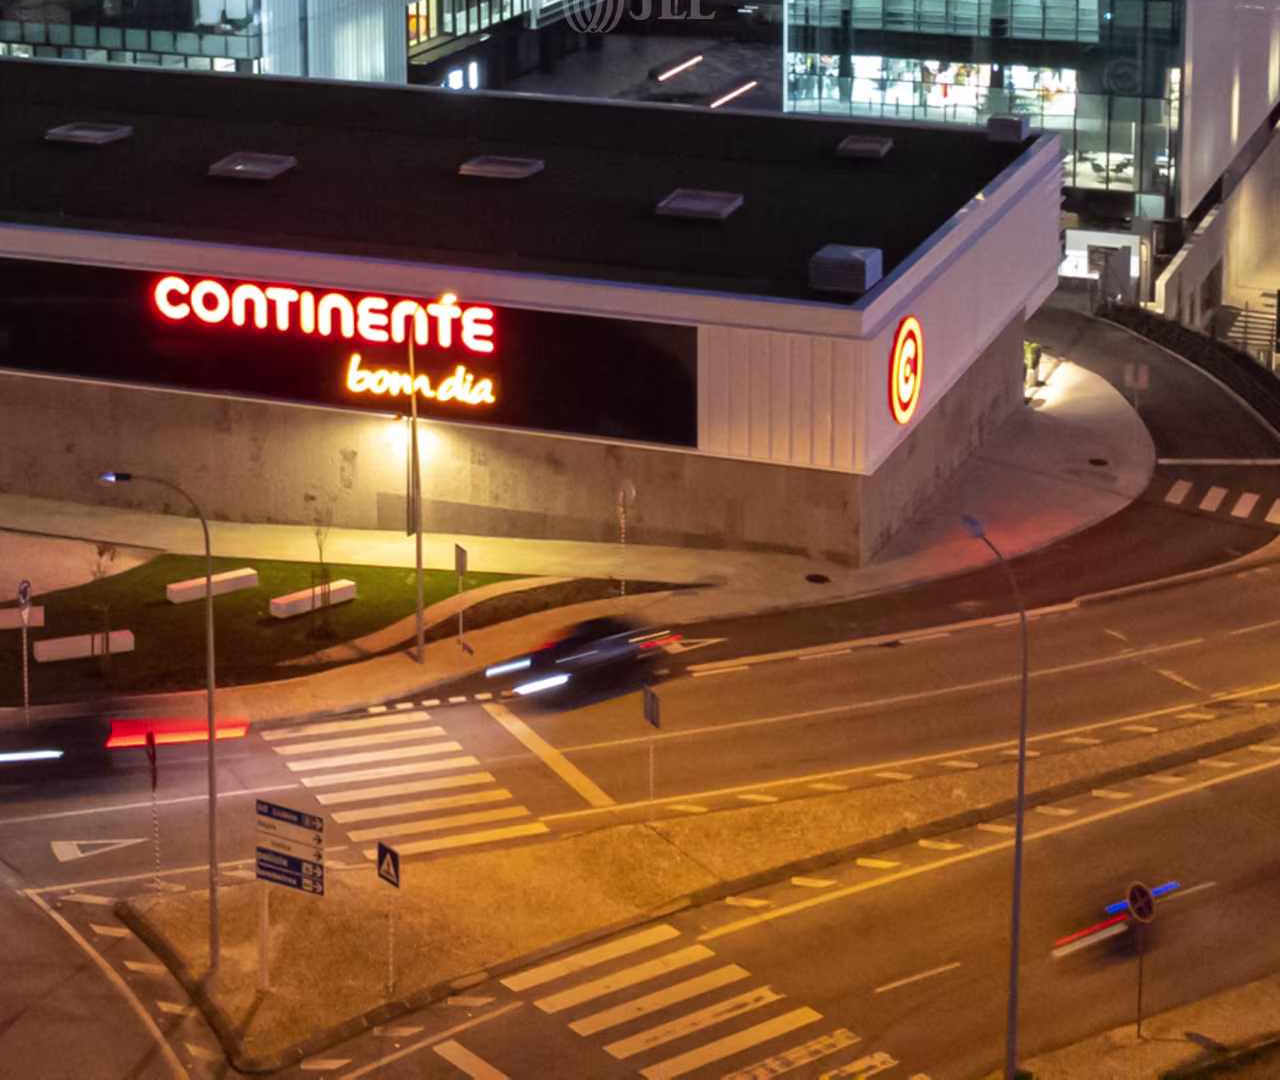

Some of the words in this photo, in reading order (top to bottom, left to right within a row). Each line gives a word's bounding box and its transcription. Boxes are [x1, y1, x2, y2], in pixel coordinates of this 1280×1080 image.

[154, 275, 495, 355] CONTINENTE
[345, 352, 441, 400] bom
[436, 365, 496, 407] dia
